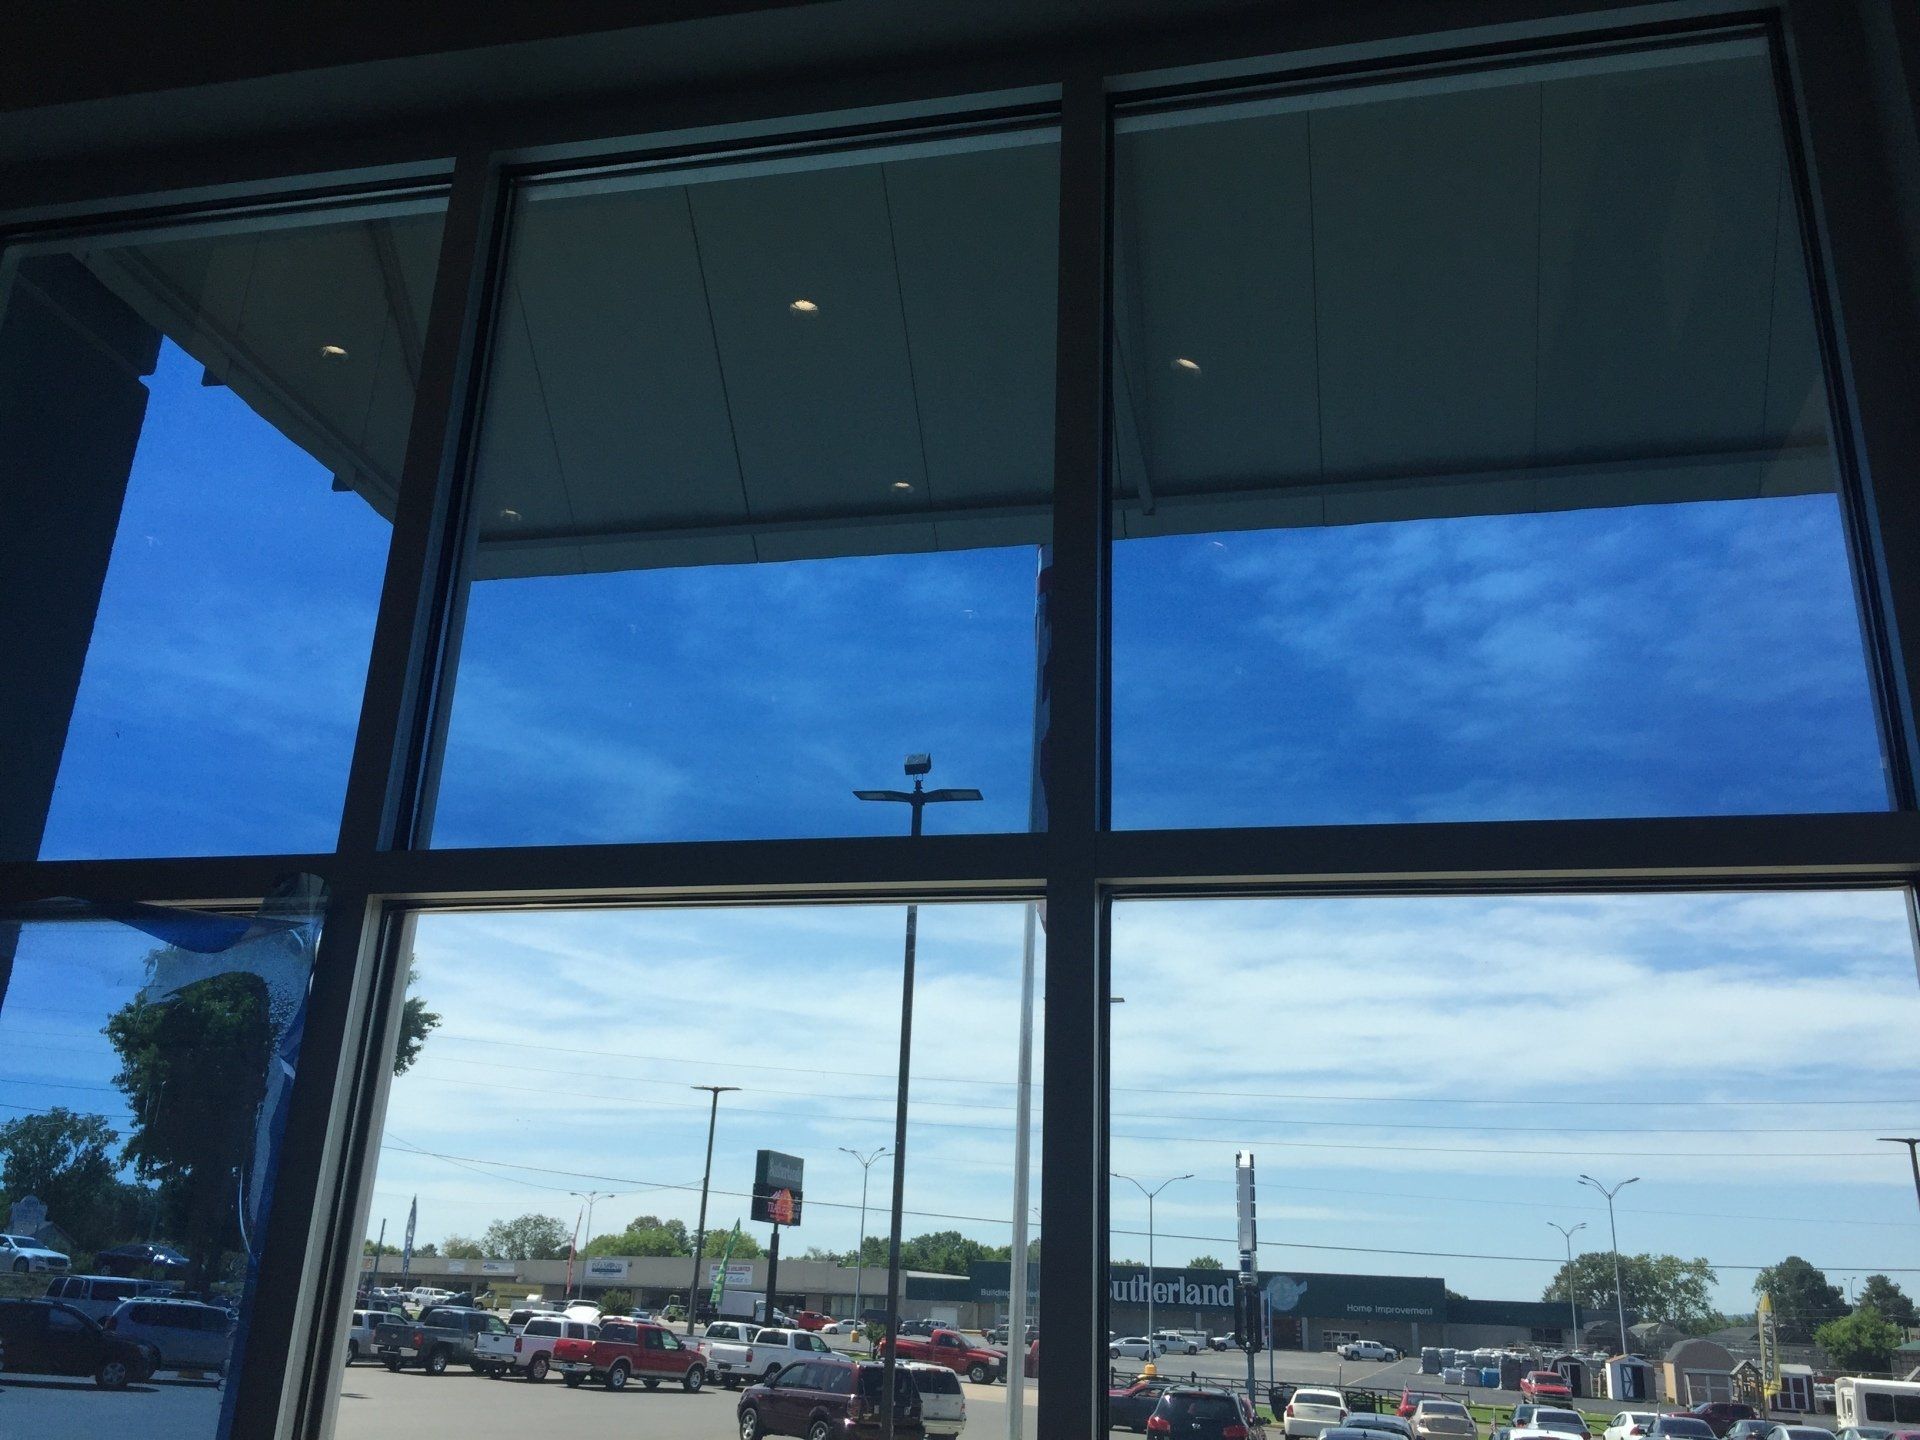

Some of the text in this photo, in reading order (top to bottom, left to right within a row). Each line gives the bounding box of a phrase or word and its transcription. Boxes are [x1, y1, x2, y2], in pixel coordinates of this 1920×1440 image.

[1109, 1274, 1235, 1307] utherland
[1346, 1304, 1433, 1315] Home Improvement
